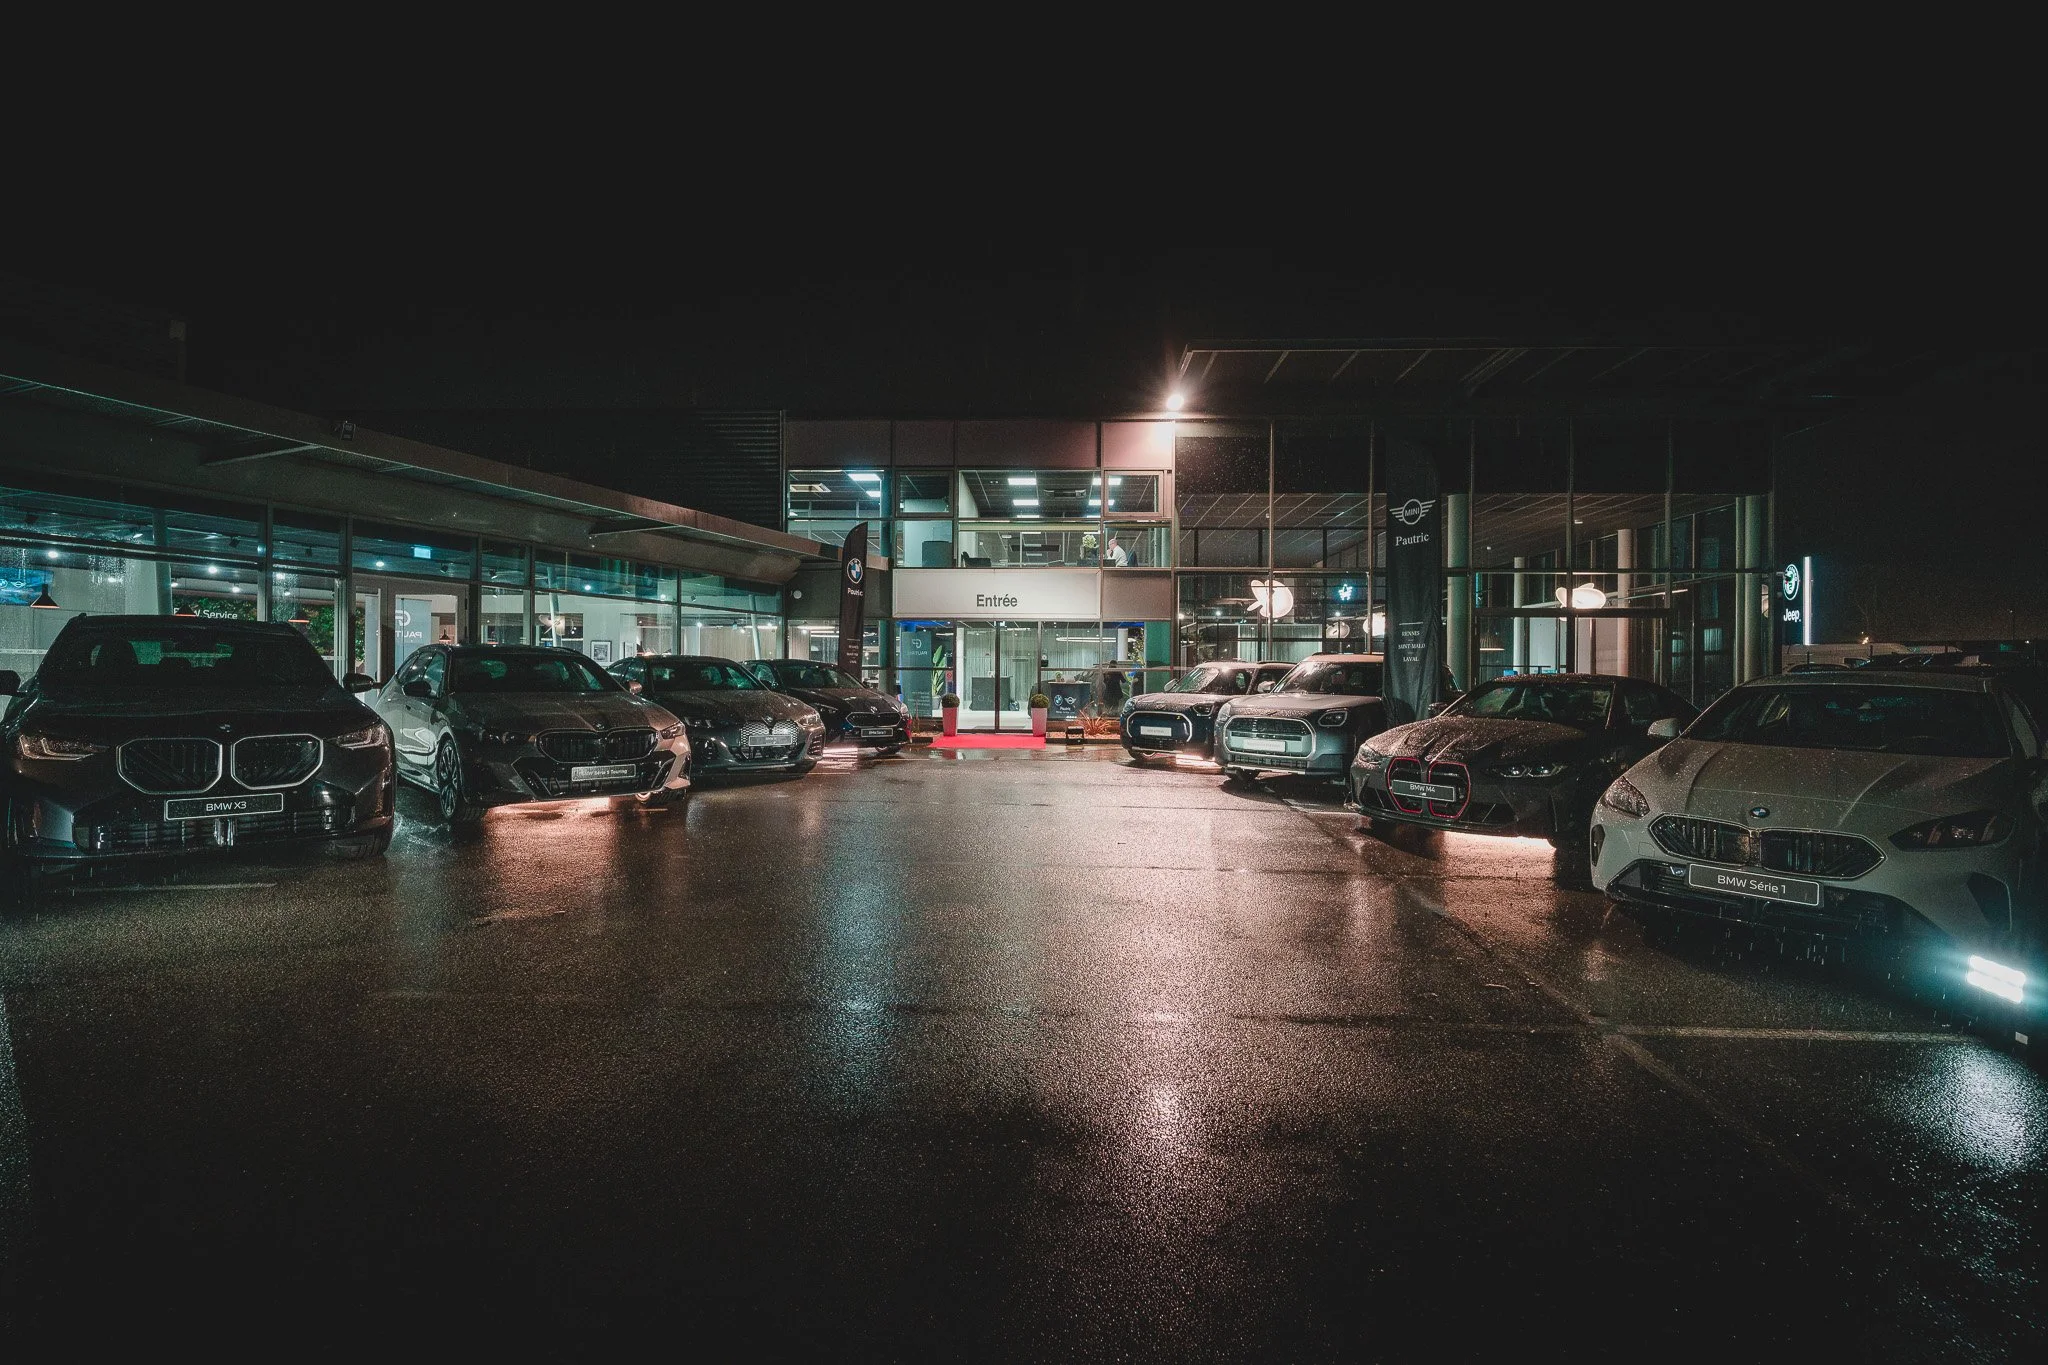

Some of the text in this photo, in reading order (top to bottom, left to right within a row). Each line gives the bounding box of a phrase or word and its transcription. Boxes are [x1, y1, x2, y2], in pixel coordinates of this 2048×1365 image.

[1404, 507, 1420, 517] MINI
[1395, 532, 1430, 546] Pautric
[976, 593, 1018, 607] Entrée
[173, 607, 238, 620] BW Service
[1410, 783, 1436, 793] BMW M4
[205, 801, 247, 811] BMW X3
[1717, 874, 1786, 894] BMW Série 1
